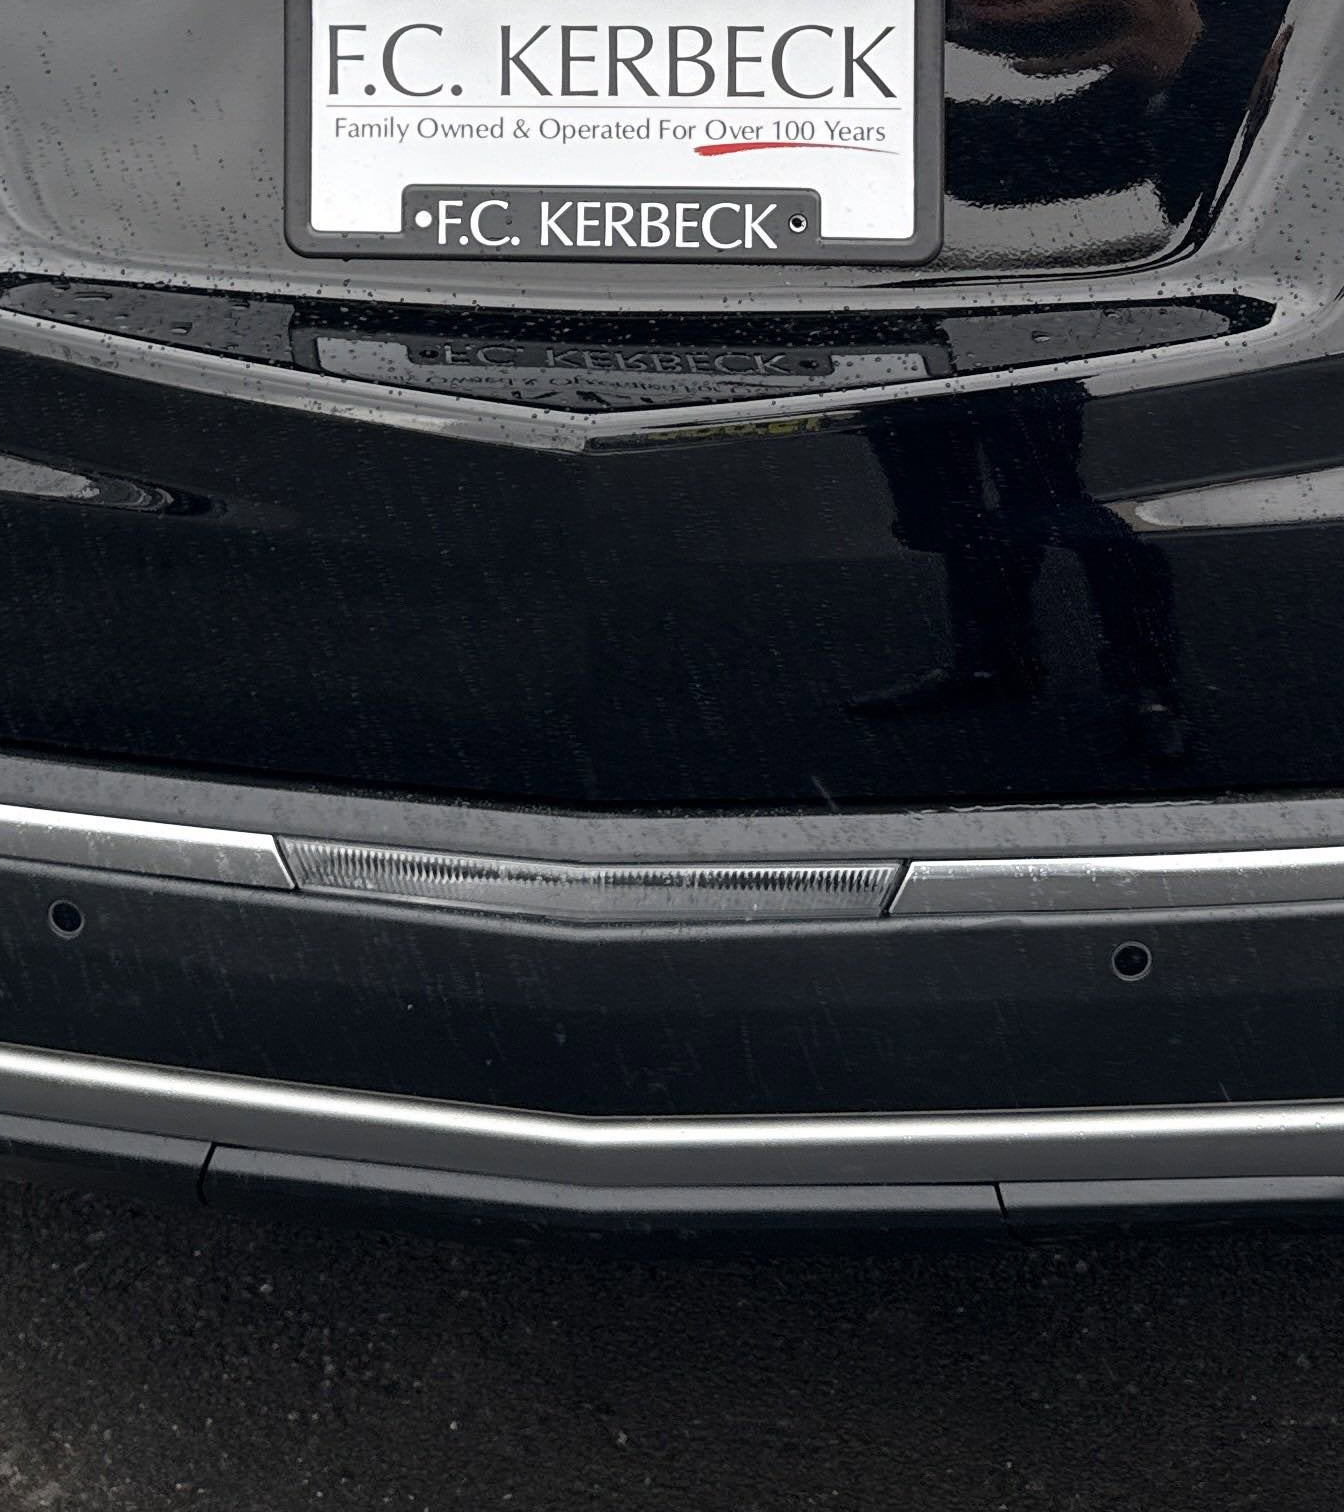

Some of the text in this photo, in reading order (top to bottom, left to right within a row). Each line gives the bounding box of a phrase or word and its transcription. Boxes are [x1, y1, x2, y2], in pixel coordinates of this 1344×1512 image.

[327, 23, 897, 100] F.C. KERBECK
[335, 117, 886, 144] Family Owned & Operated For Over 100 Years
[438, 199, 778, 249] F.C. KERBECK
